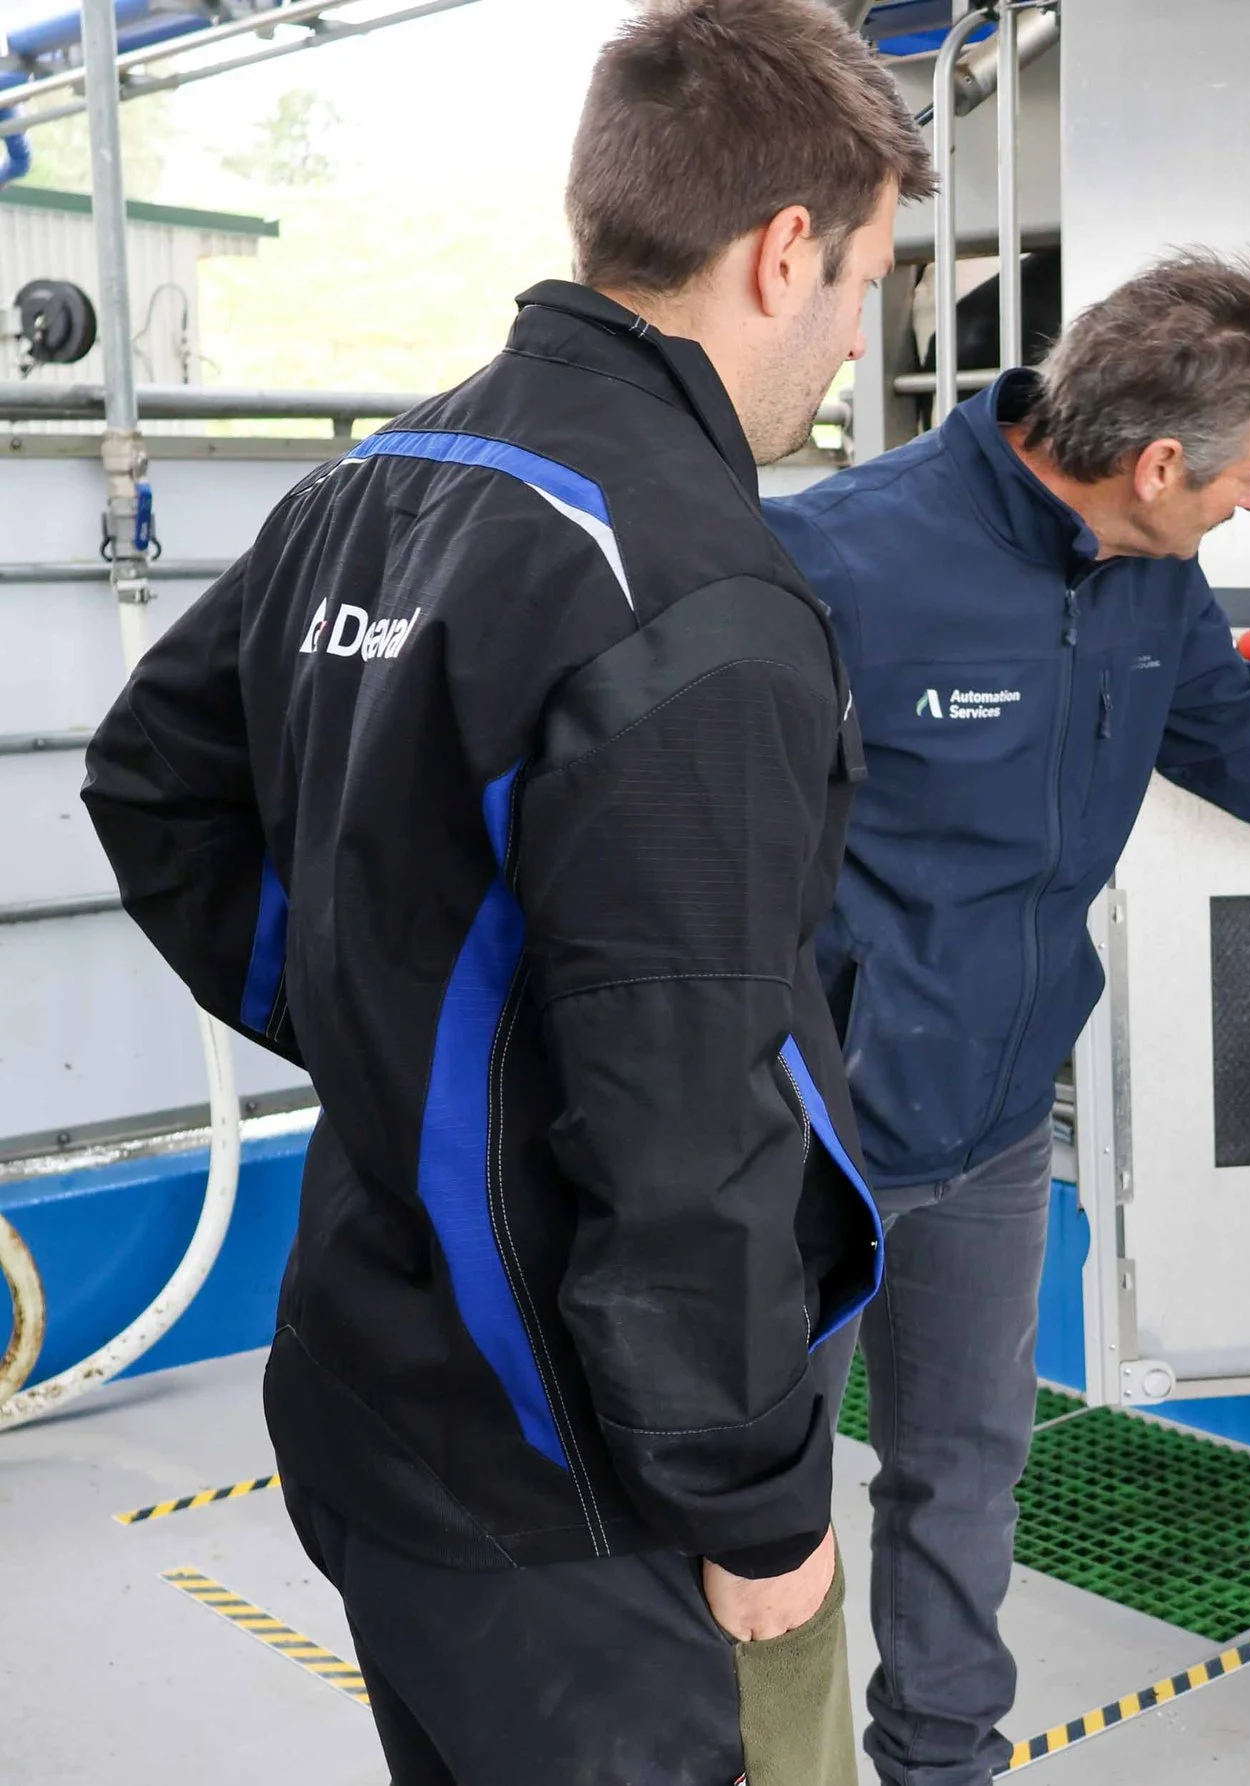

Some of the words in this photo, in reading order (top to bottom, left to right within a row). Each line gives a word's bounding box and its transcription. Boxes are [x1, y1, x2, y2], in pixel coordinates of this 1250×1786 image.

[326, 603, 421, 662] Deaval
[950, 689, 1021, 703] Automation
[949, 704, 1001, 719] Services
